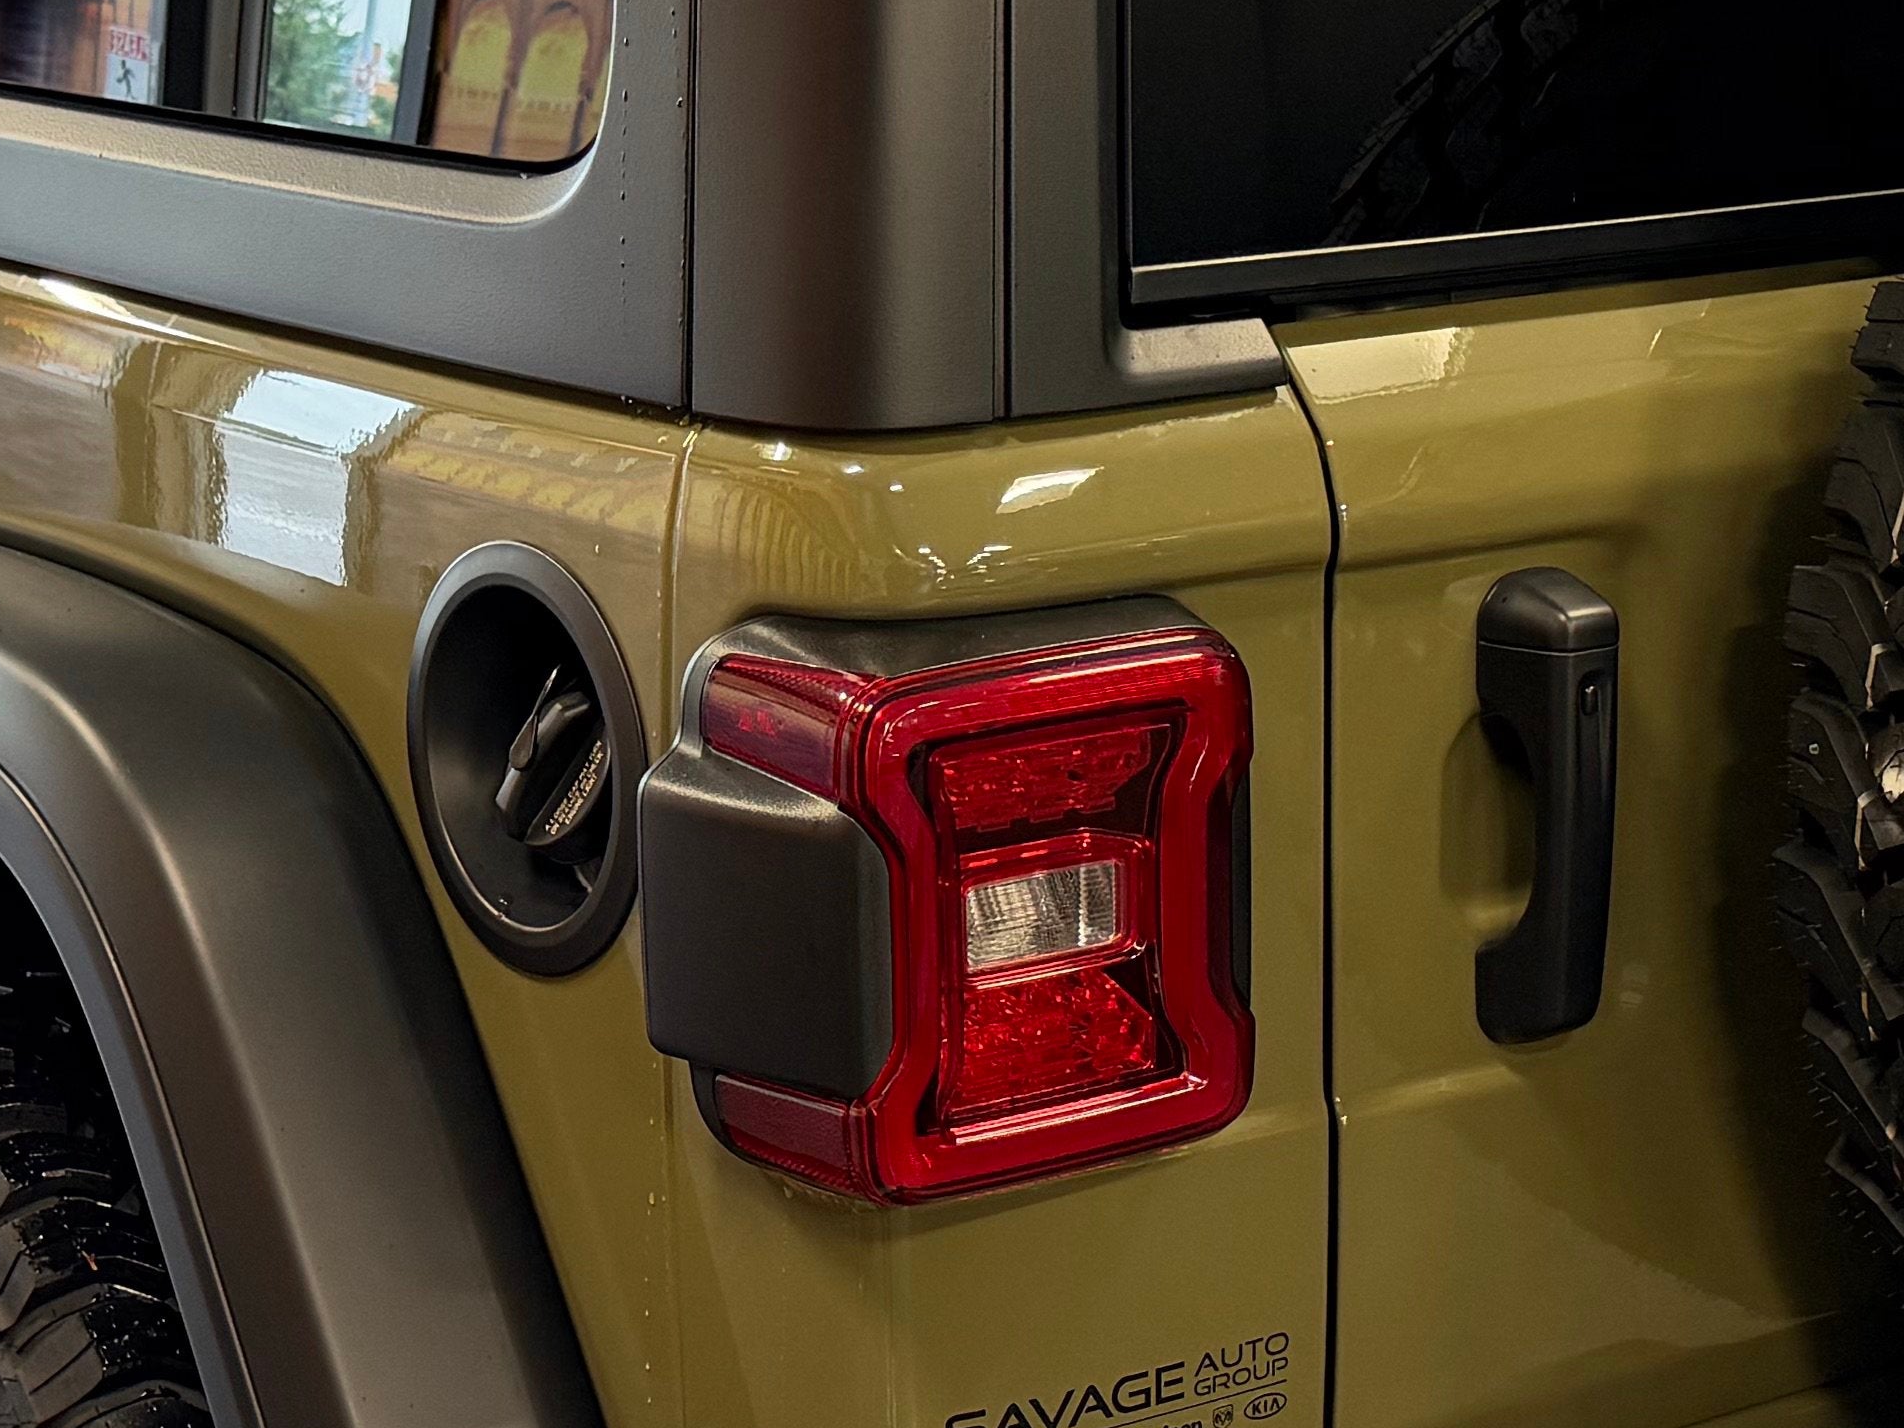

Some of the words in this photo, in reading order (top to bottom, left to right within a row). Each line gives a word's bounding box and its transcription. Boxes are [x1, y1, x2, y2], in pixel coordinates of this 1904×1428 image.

[1195, 1332, 1289, 1378] AUTO
[1195, 1357, 1289, 1397] GROUP
[1249, 1395, 1283, 1417] KIA
